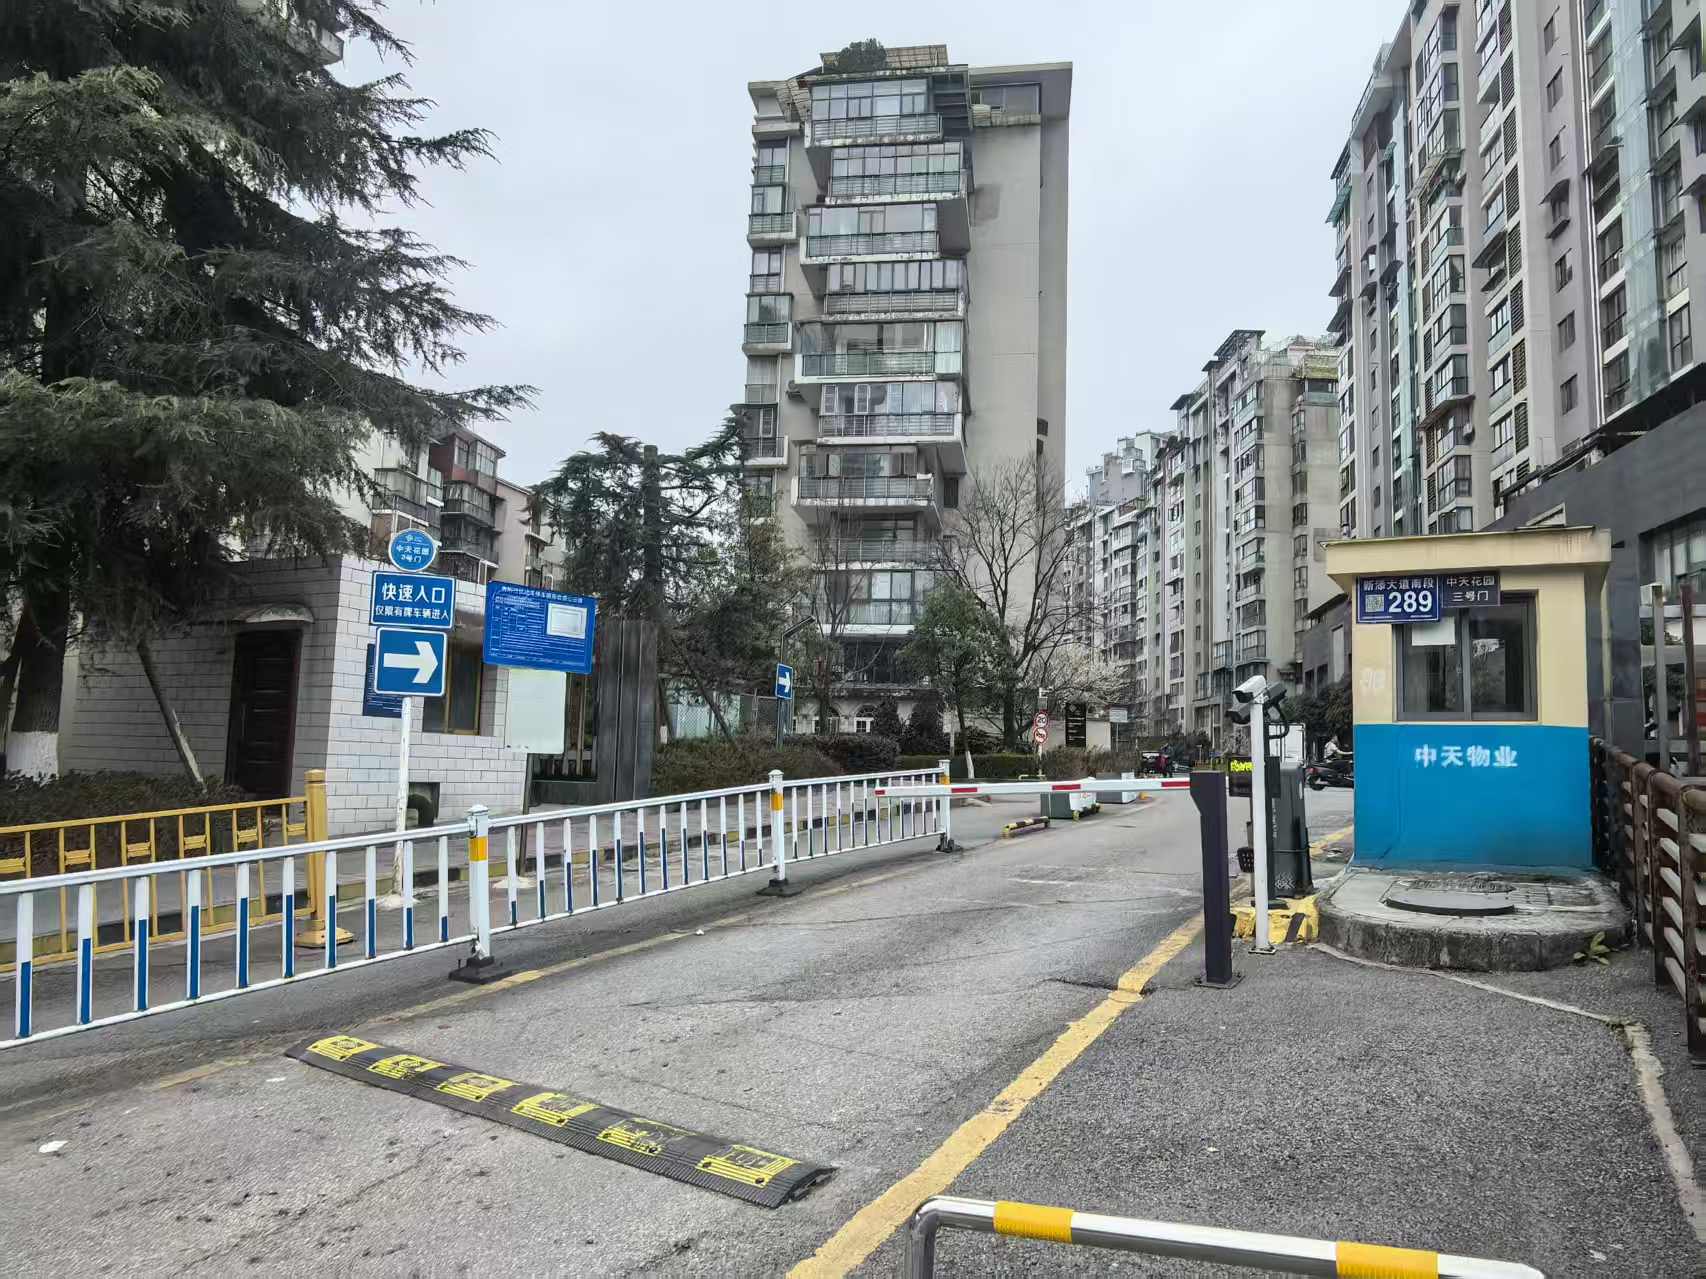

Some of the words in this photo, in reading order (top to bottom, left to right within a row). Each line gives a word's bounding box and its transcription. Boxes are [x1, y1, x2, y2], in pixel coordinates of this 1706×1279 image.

[1447, 576, 1495, 587] 中天花园
[381, 582, 445, 604] 快速入口
[1388, 590, 1432, 613] 289
[1452, 590, 1489, 602] 三号门
[375, 605, 449, 621] 仅限有牌车辆进入
[1414, 743, 1518, 768] 中天物业
